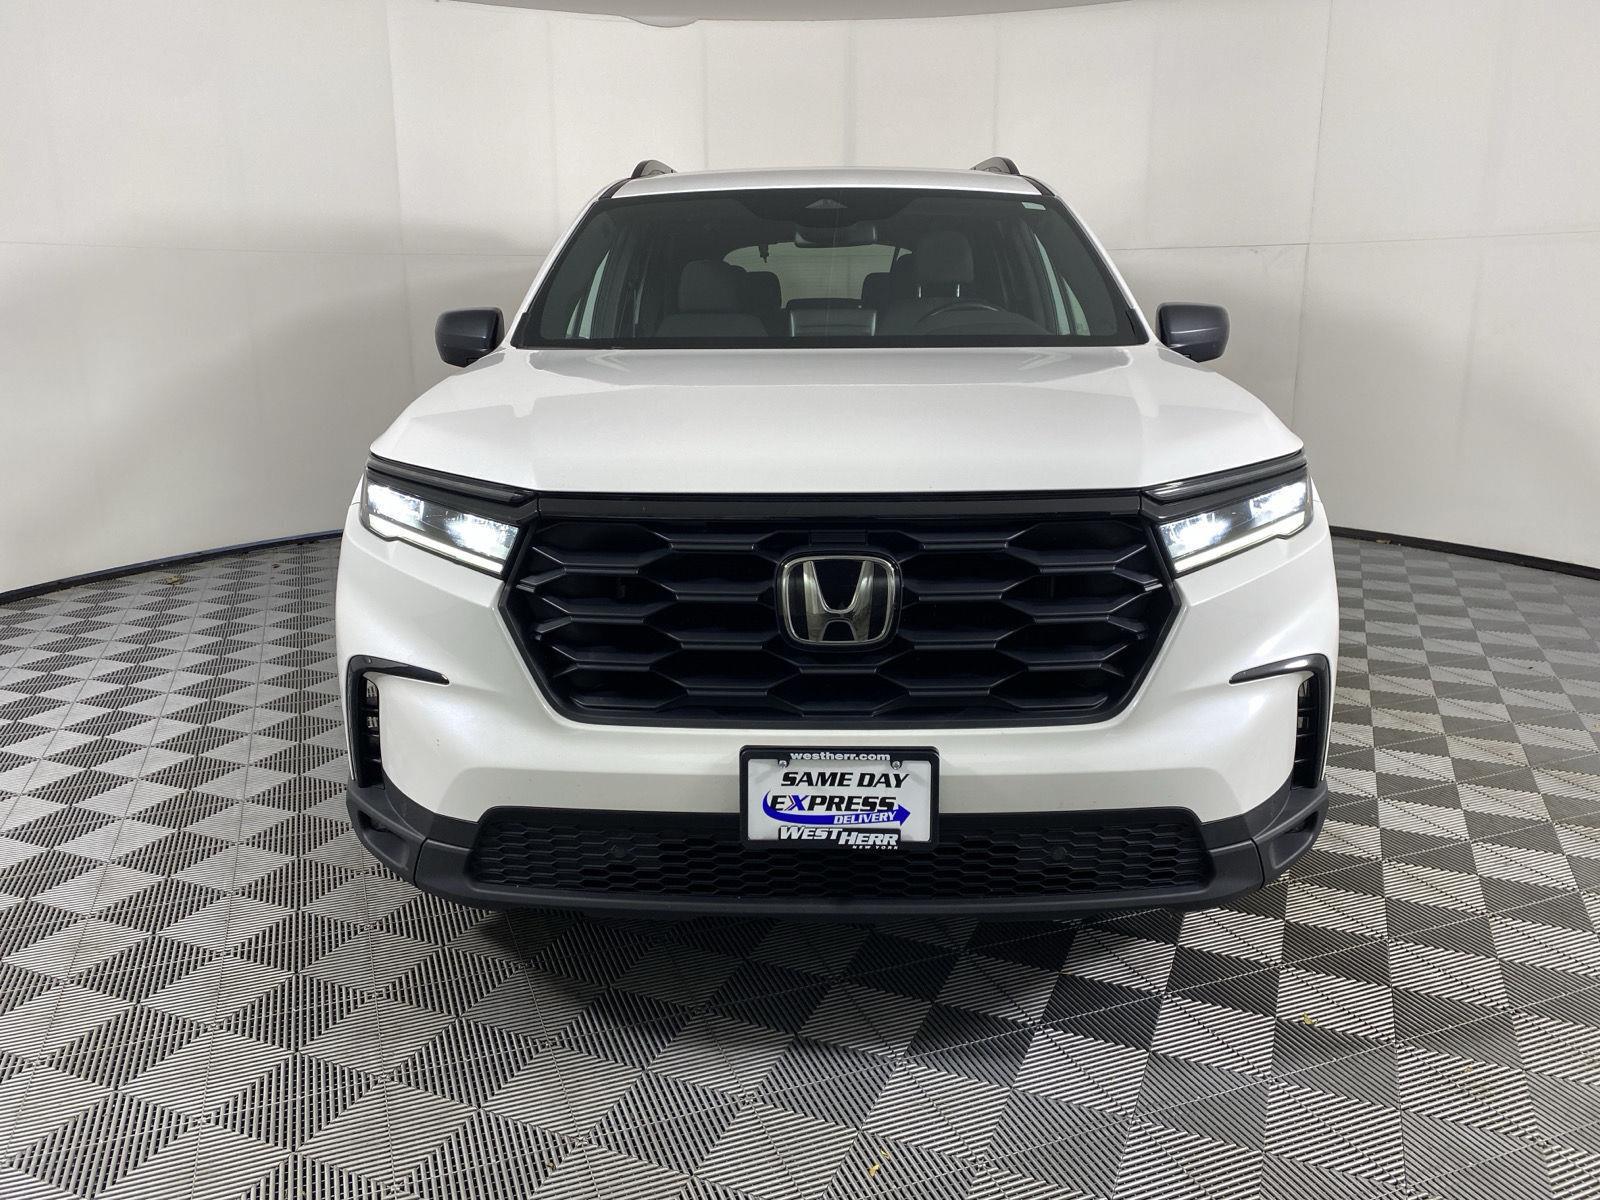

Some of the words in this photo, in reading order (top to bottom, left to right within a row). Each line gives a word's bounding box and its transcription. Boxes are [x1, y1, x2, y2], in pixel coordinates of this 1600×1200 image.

[790, 752, 890, 761] westherr.com
[781, 772, 853, 787] SAME
[857, 773, 909, 788] DAY
[770, 795, 896, 811] EXPRESS
[833, 811, 897, 824] DELIVERY
